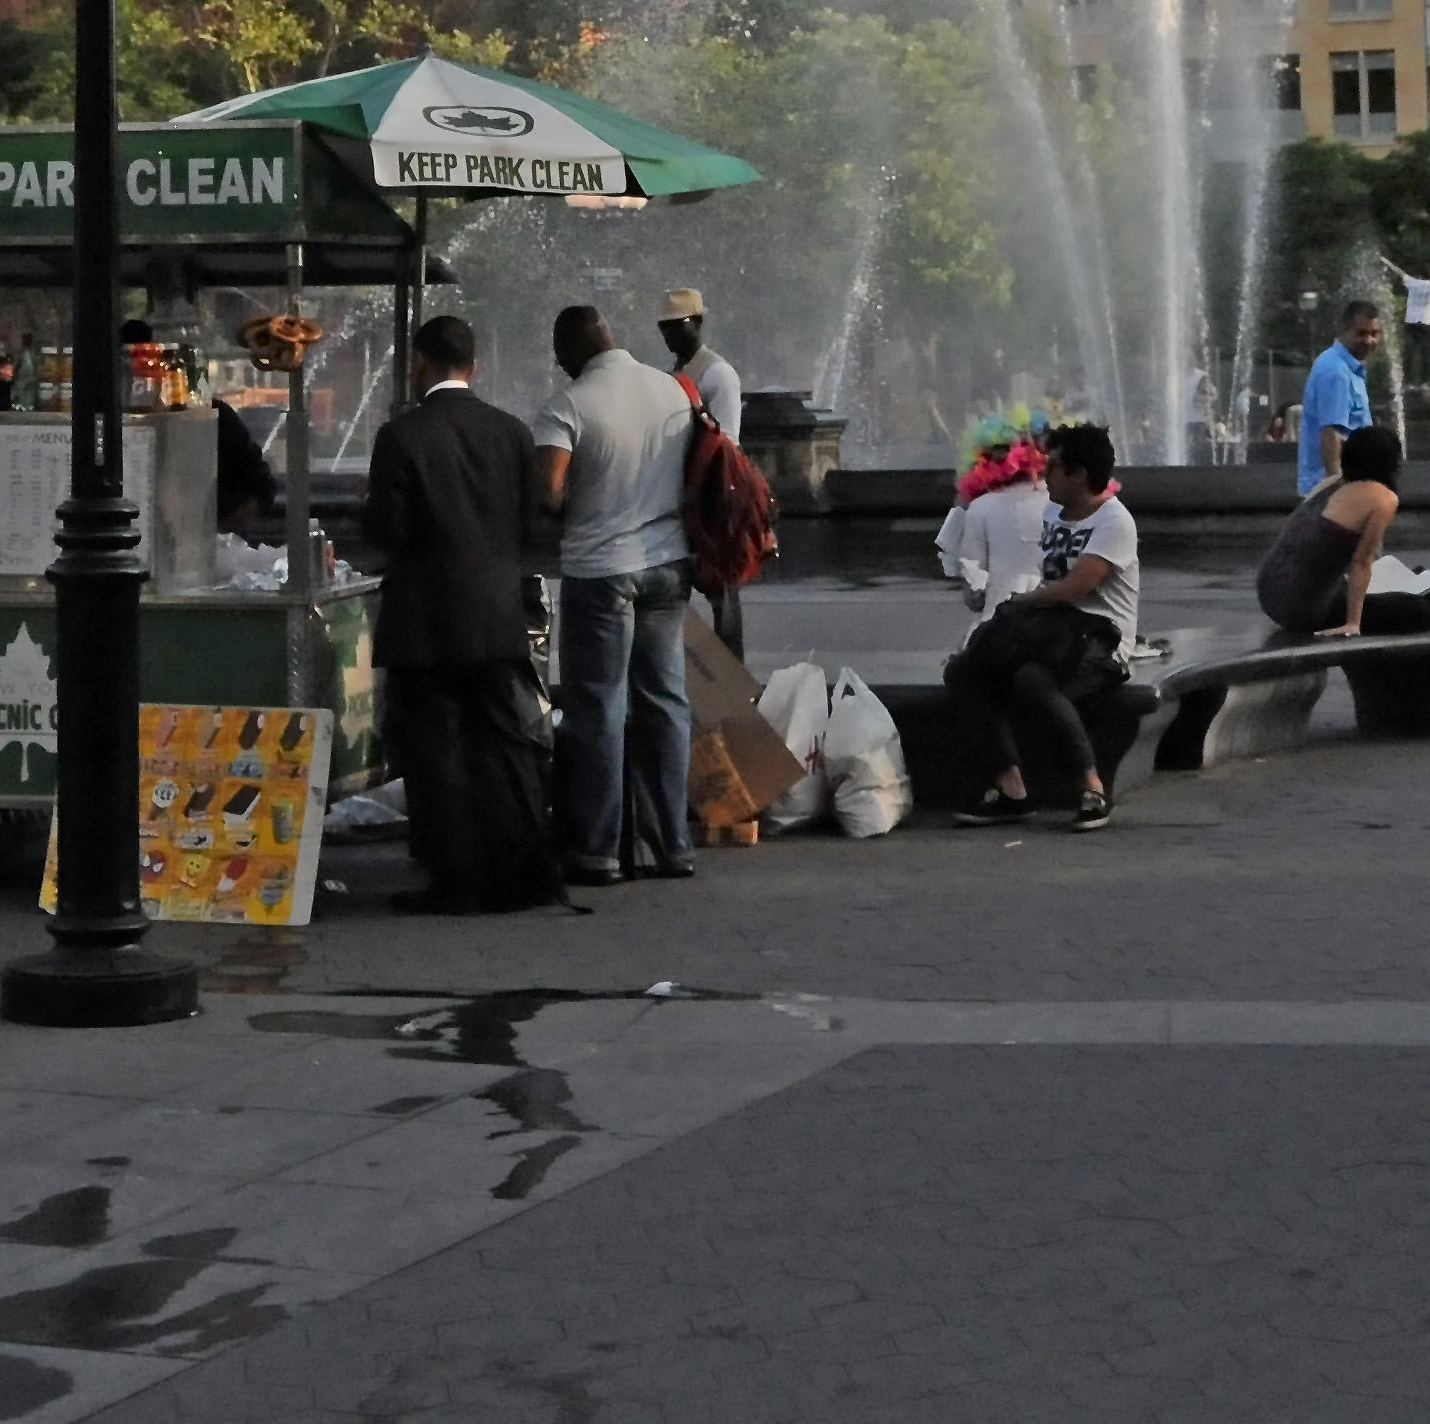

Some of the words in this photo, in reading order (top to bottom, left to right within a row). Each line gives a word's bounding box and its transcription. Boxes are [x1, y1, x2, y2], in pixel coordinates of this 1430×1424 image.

[126, 157, 284, 206] CLEAN
[398, 151, 458, 183] KEEP
[465, 154, 526, 188] PARK
[531, 159, 604, 191] CLEAN
